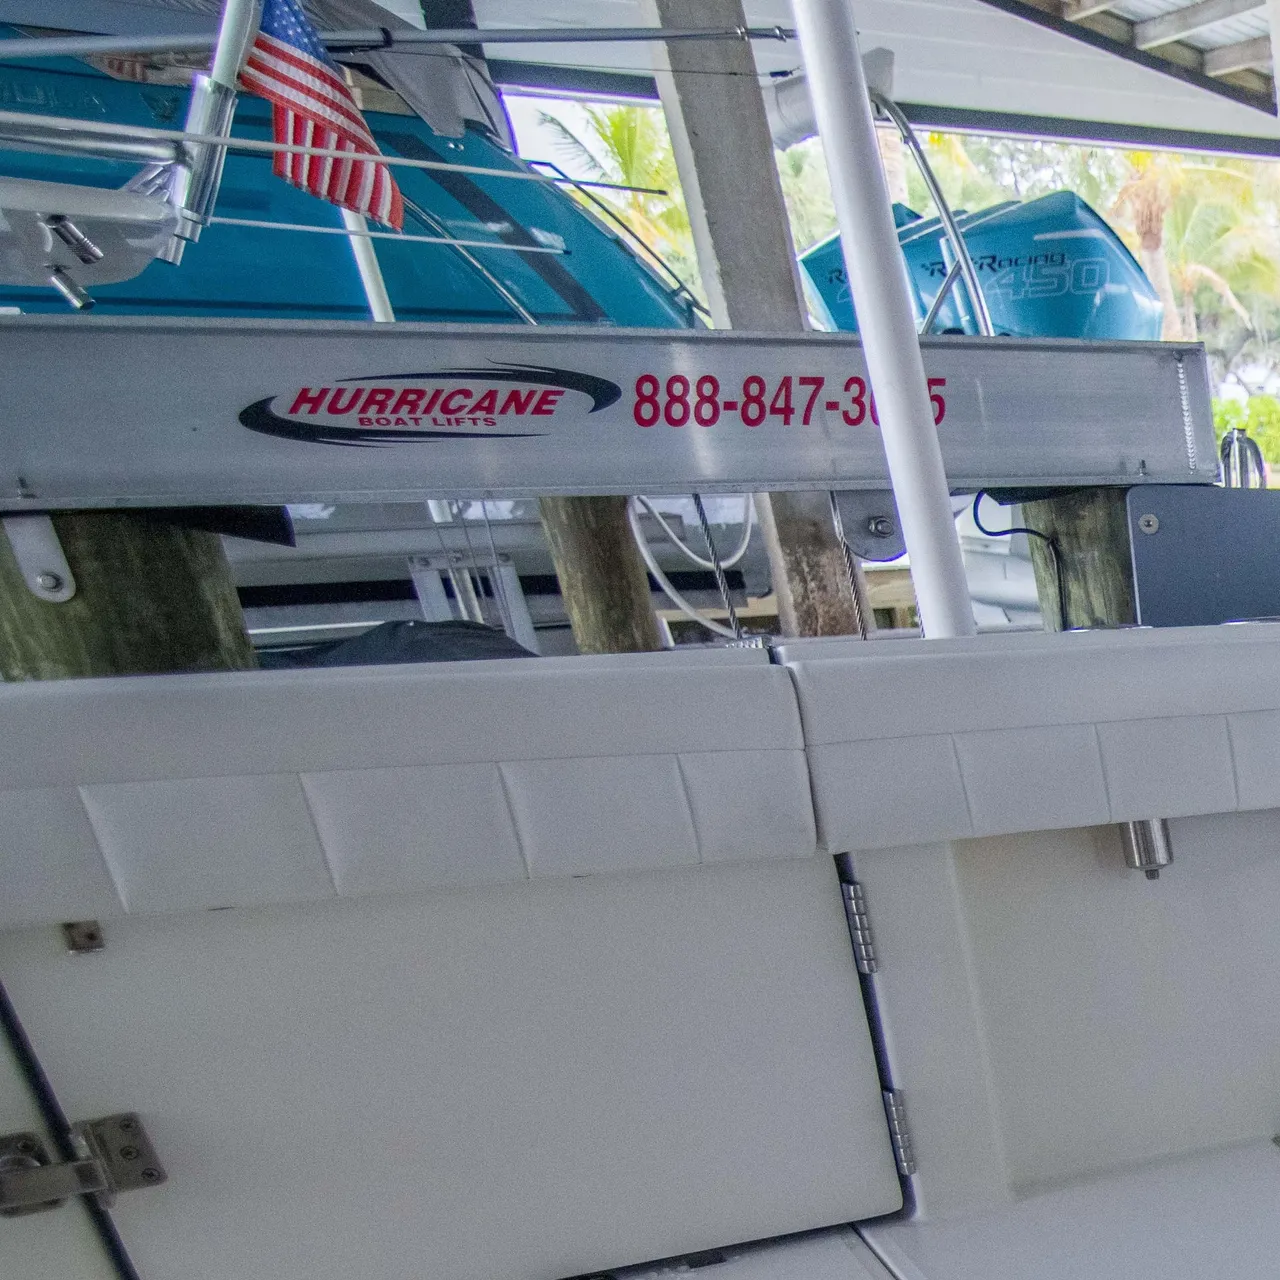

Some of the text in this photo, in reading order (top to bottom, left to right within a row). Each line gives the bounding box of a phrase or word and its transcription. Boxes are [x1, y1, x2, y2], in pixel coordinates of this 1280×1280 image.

[984, 258, 1110, 300] 450
[288, 387, 565, 416] HURRICANE
[633, 373, 947, 428] 888-847-35
[358, 417, 497, 427] BOAT LIFTS
